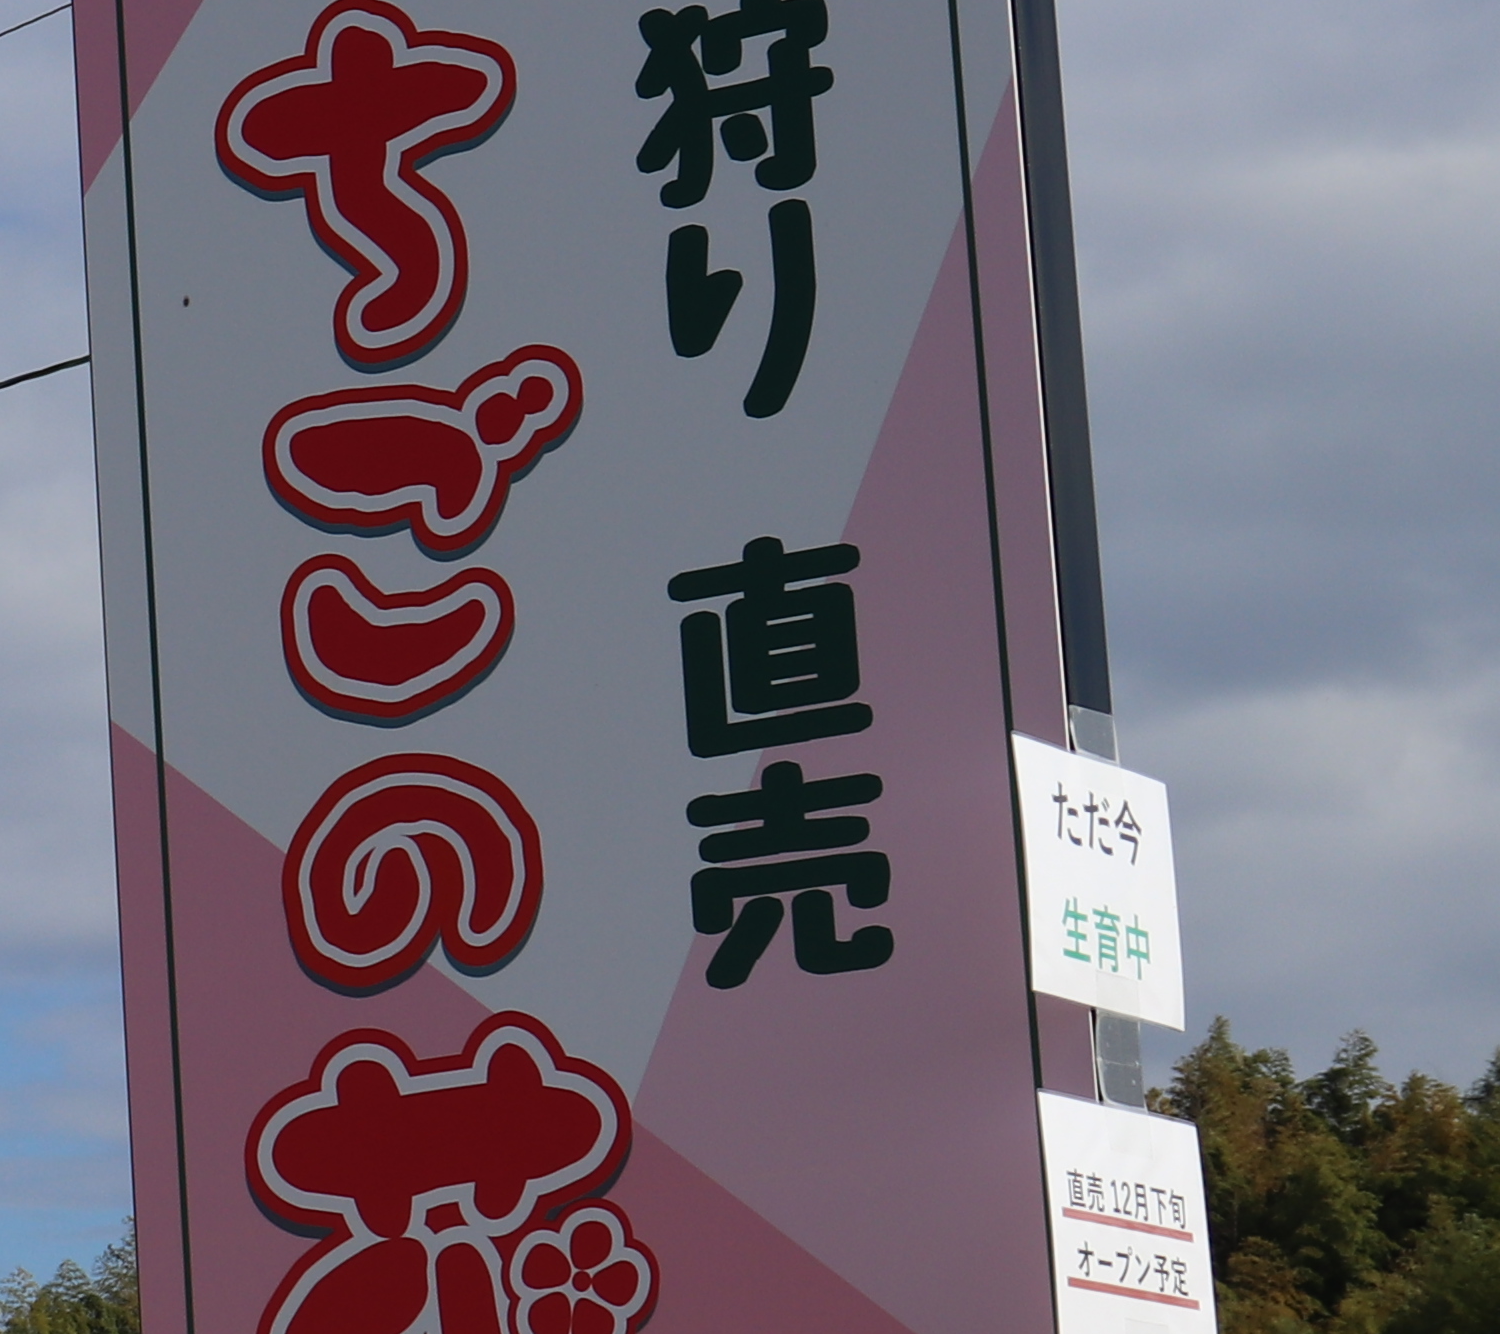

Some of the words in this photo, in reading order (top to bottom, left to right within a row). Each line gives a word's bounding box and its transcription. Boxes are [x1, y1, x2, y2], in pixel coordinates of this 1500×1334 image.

[666, 537, 894, 989] 直売
[1052, 780, 1142, 866] ただ今
[1062, 896, 1151, 981] 生育中
[1077, 1240, 1189, 1297] オープン予定
